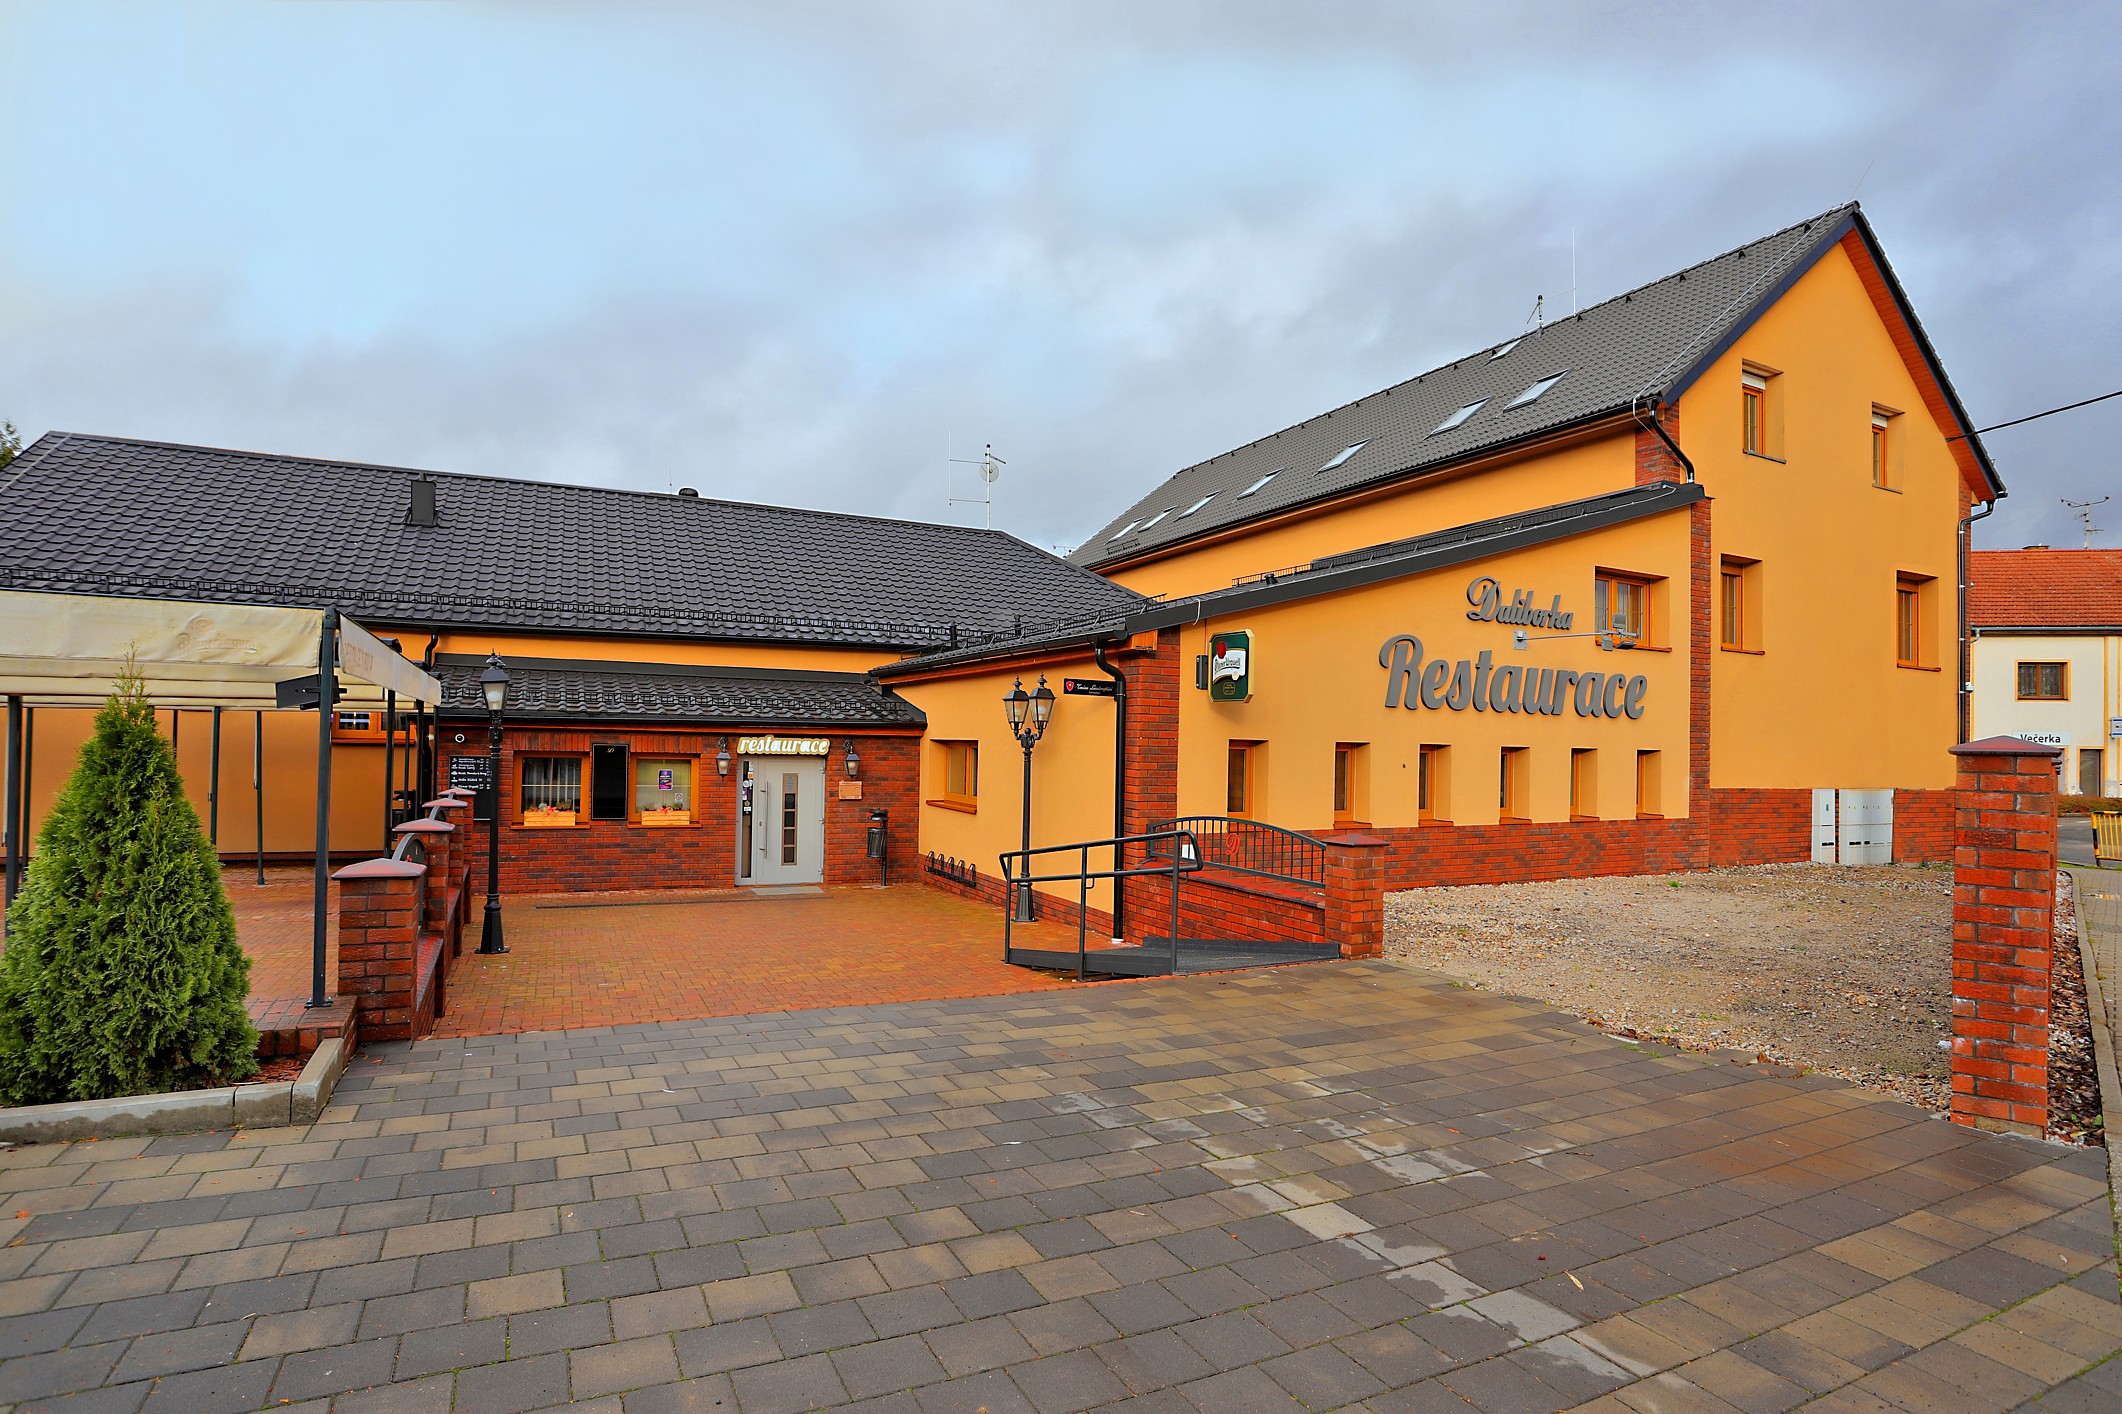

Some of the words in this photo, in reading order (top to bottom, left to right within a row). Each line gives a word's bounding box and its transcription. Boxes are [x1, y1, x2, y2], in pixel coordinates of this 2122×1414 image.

[1466, 576, 1574, 630] Daliborka
[1378, 634, 1648, 719] Restaurace
[739, 735, 829, 753] restaurace
[2020, 733, 2061, 743] Večerka
